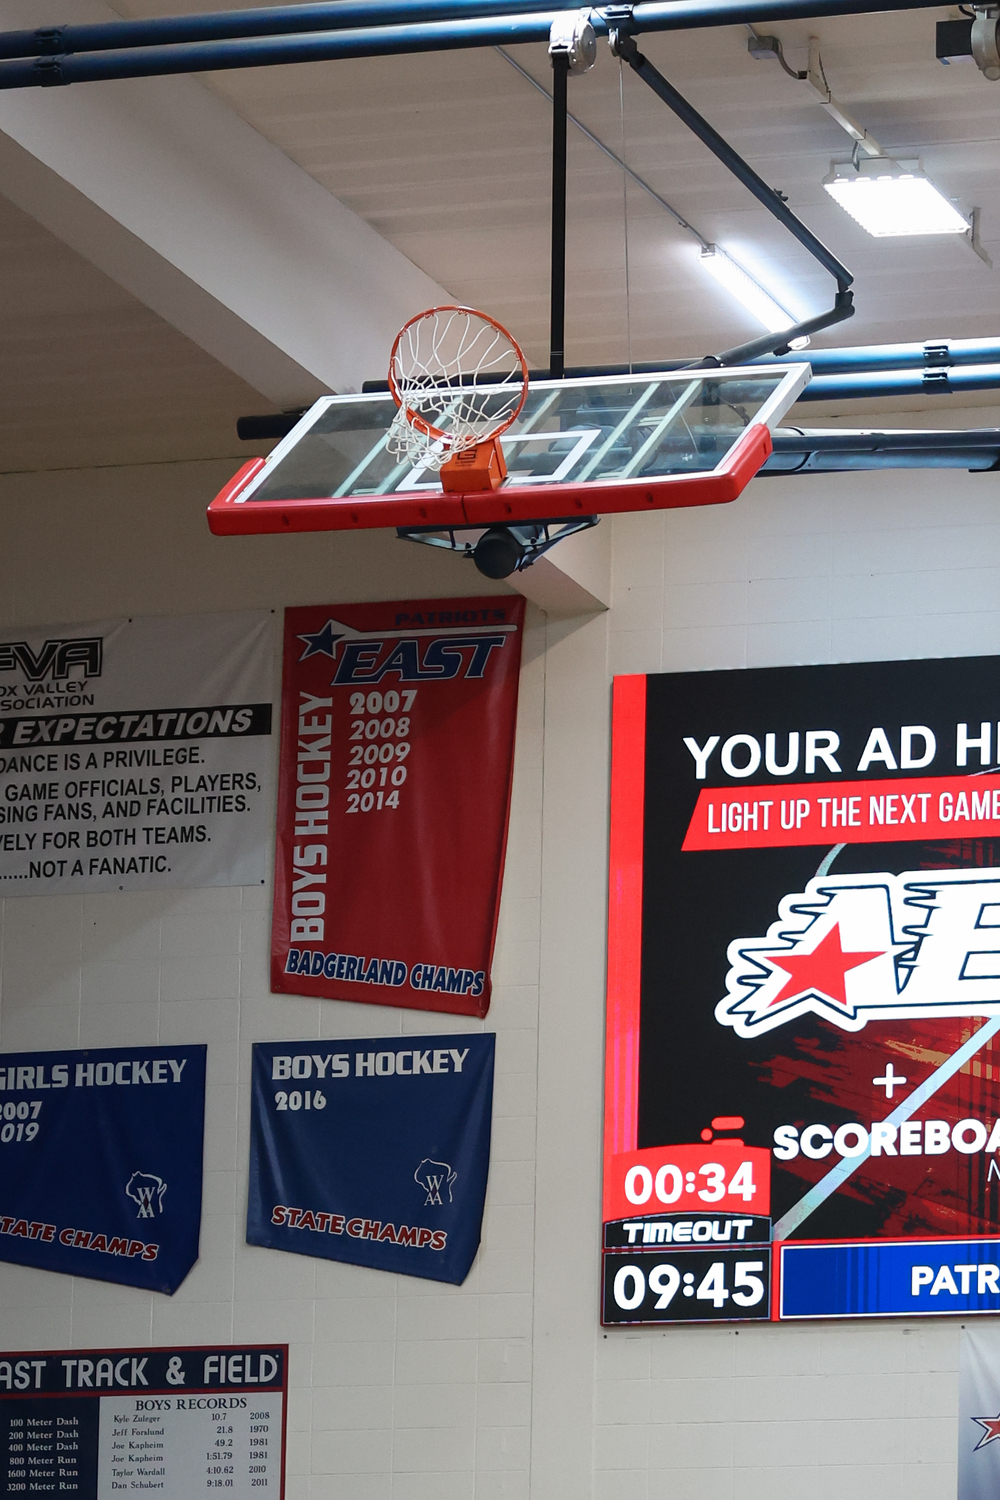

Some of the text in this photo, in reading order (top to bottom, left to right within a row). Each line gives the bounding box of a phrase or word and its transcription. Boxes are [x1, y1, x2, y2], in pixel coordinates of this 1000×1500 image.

[395, 609, 506, 625] PATRIOTS
[330, 635, 507, 686] EAST
[23, 681, 88, 695] VALLEY
[349, 689, 418, 715] 2007
[12, 708, 253, 745] EXPECTATIONS
[348, 717, 411, 740] 2008
[64, 753, 81, 771] IS
[85, 752, 98, 769] A
[103, 747, 205, 768] PRIVILEGE.
[294, 691, 333, 836] HOCKEY
[347, 742, 411, 765] 2009
[682, 730, 842, 779] YOUR
[857, 725, 936, 772] AD
[5, 773, 261, 801] GAME OFFICIALS, PLAYERS,
[344, 765, 407, 790] 2010
[44, 802, 96, 822] FANS,
[102, 800, 141, 819] AND
[146, 795, 250, 816] FACILITIES.
[345, 790, 400, 814] 2014
[707, 800, 773, 833] LIGHT
[780, 799, 810, 830] UP
[817, 796, 861, 828] THE
[869, 793, 931, 826] NEXT
[0, 825, 211, 851] ELY FOR BOTH TEAMS.
[71, 859, 84, 876] A
[89, 855, 171, 875] FANATIC.
[290, 844, 328, 941] BOYS
[284, 949, 486, 997] BADGERLAND CHAMPS
[74, 1059, 187, 1087] HOCKEY
[271, 1048, 470, 1080] BOYS HOCKEY
[0, 1101, 42, 1121] 007
[274, 1089, 327, 1111] 2016
[624, 1161, 756, 1205] 00:34
[0, 1215, 159, 1262] TATE CHAMPS
[271, 1205, 448, 1250] STATE CHAMPS
[623, 1219, 753, 1243] TIMEOUT
[613, 1261, 765, 1310] 09:45
[61, 1357, 149, 1388] TRACK
[166, 1356, 186, 1385] &
[203, 1354, 278, 1384] FIELD
[135, 1397, 248, 1411] BOYS RECORDS
[211, 1413, 227, 1421] 10.7
[249, 1412, 270, 1420] 2008
[10, 1416, 79, 1427] 100 Meter Dash
[249, 1425, 269, 1433] 1970
[8, 1429, 79, 1440] 200 Meter Dash
[111, 1468, 133, 1477] Taylor
[248, 1465, 267, 1473] 2010
[111, 1478, 268, 1489] Dan Schubert 2011
